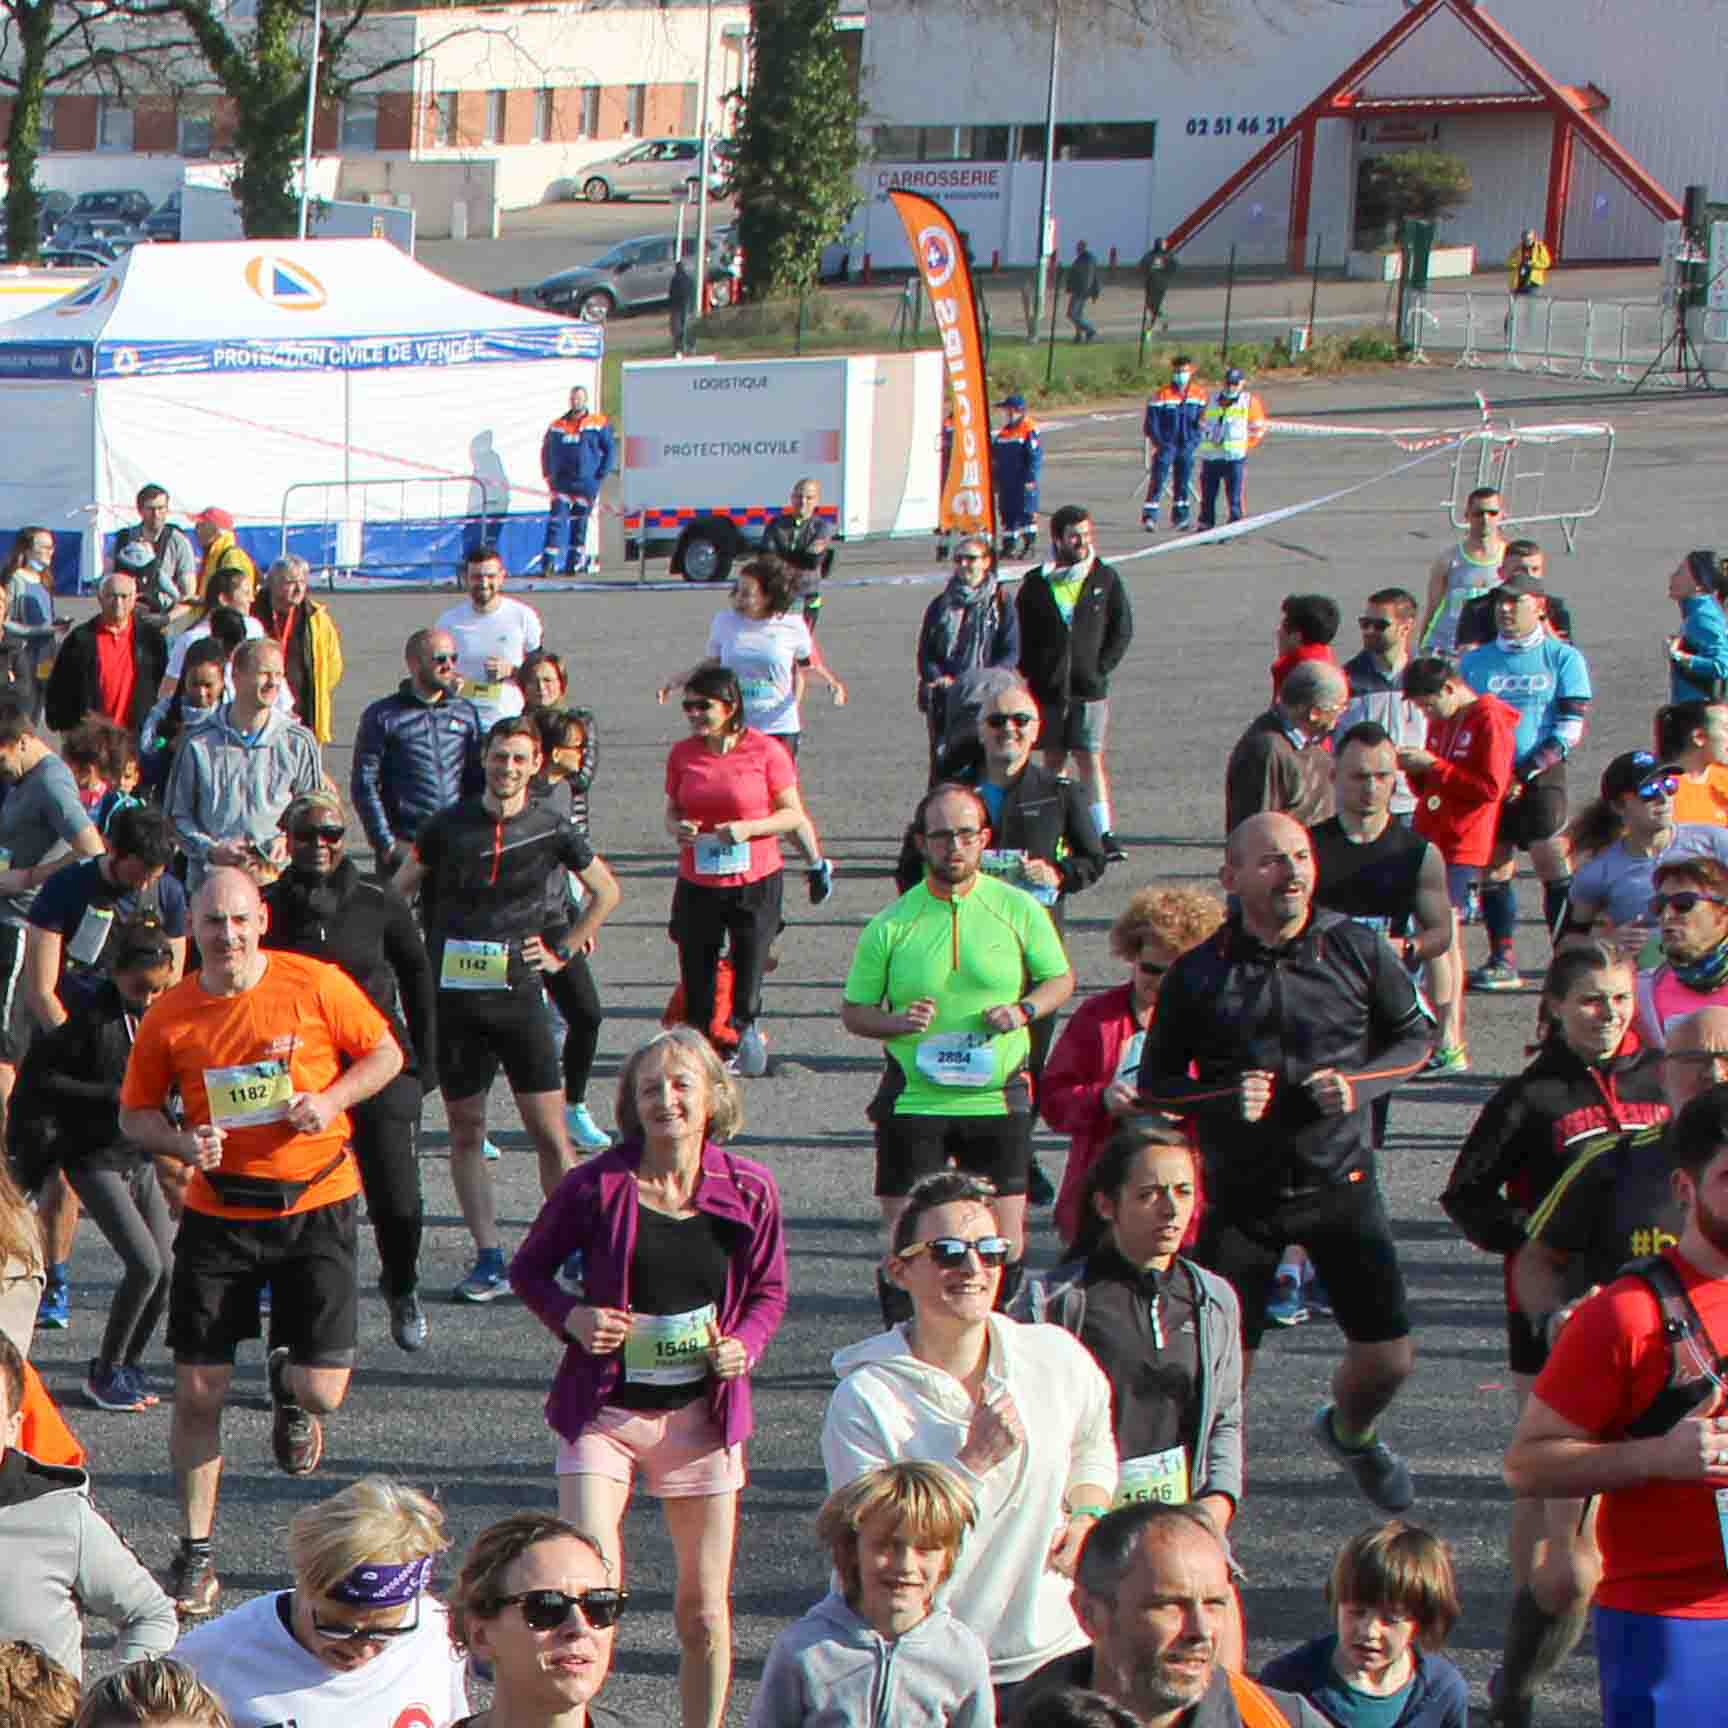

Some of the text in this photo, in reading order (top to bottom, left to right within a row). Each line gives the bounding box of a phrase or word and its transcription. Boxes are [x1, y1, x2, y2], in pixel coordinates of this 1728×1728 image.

[1186, 118, 1209, 136] 02
[1213, 117, 1231, 136] 51
[1237, 117, 1260, 136] 46
[878, 170, 1000, 187] CARROSSERIE
[213, 346, 324, 367] PROTECTION
[328, 344, 385, 364] CIVILE
[388, 342, 411, 362] DE
[692, 375, 768, 391] LOGISTIQUE
[663, 440, 800, 458] PROTECTION CIVILE
[459, 959, 488, 971] 1142
[228, 1087, 267, 1102] 1182
